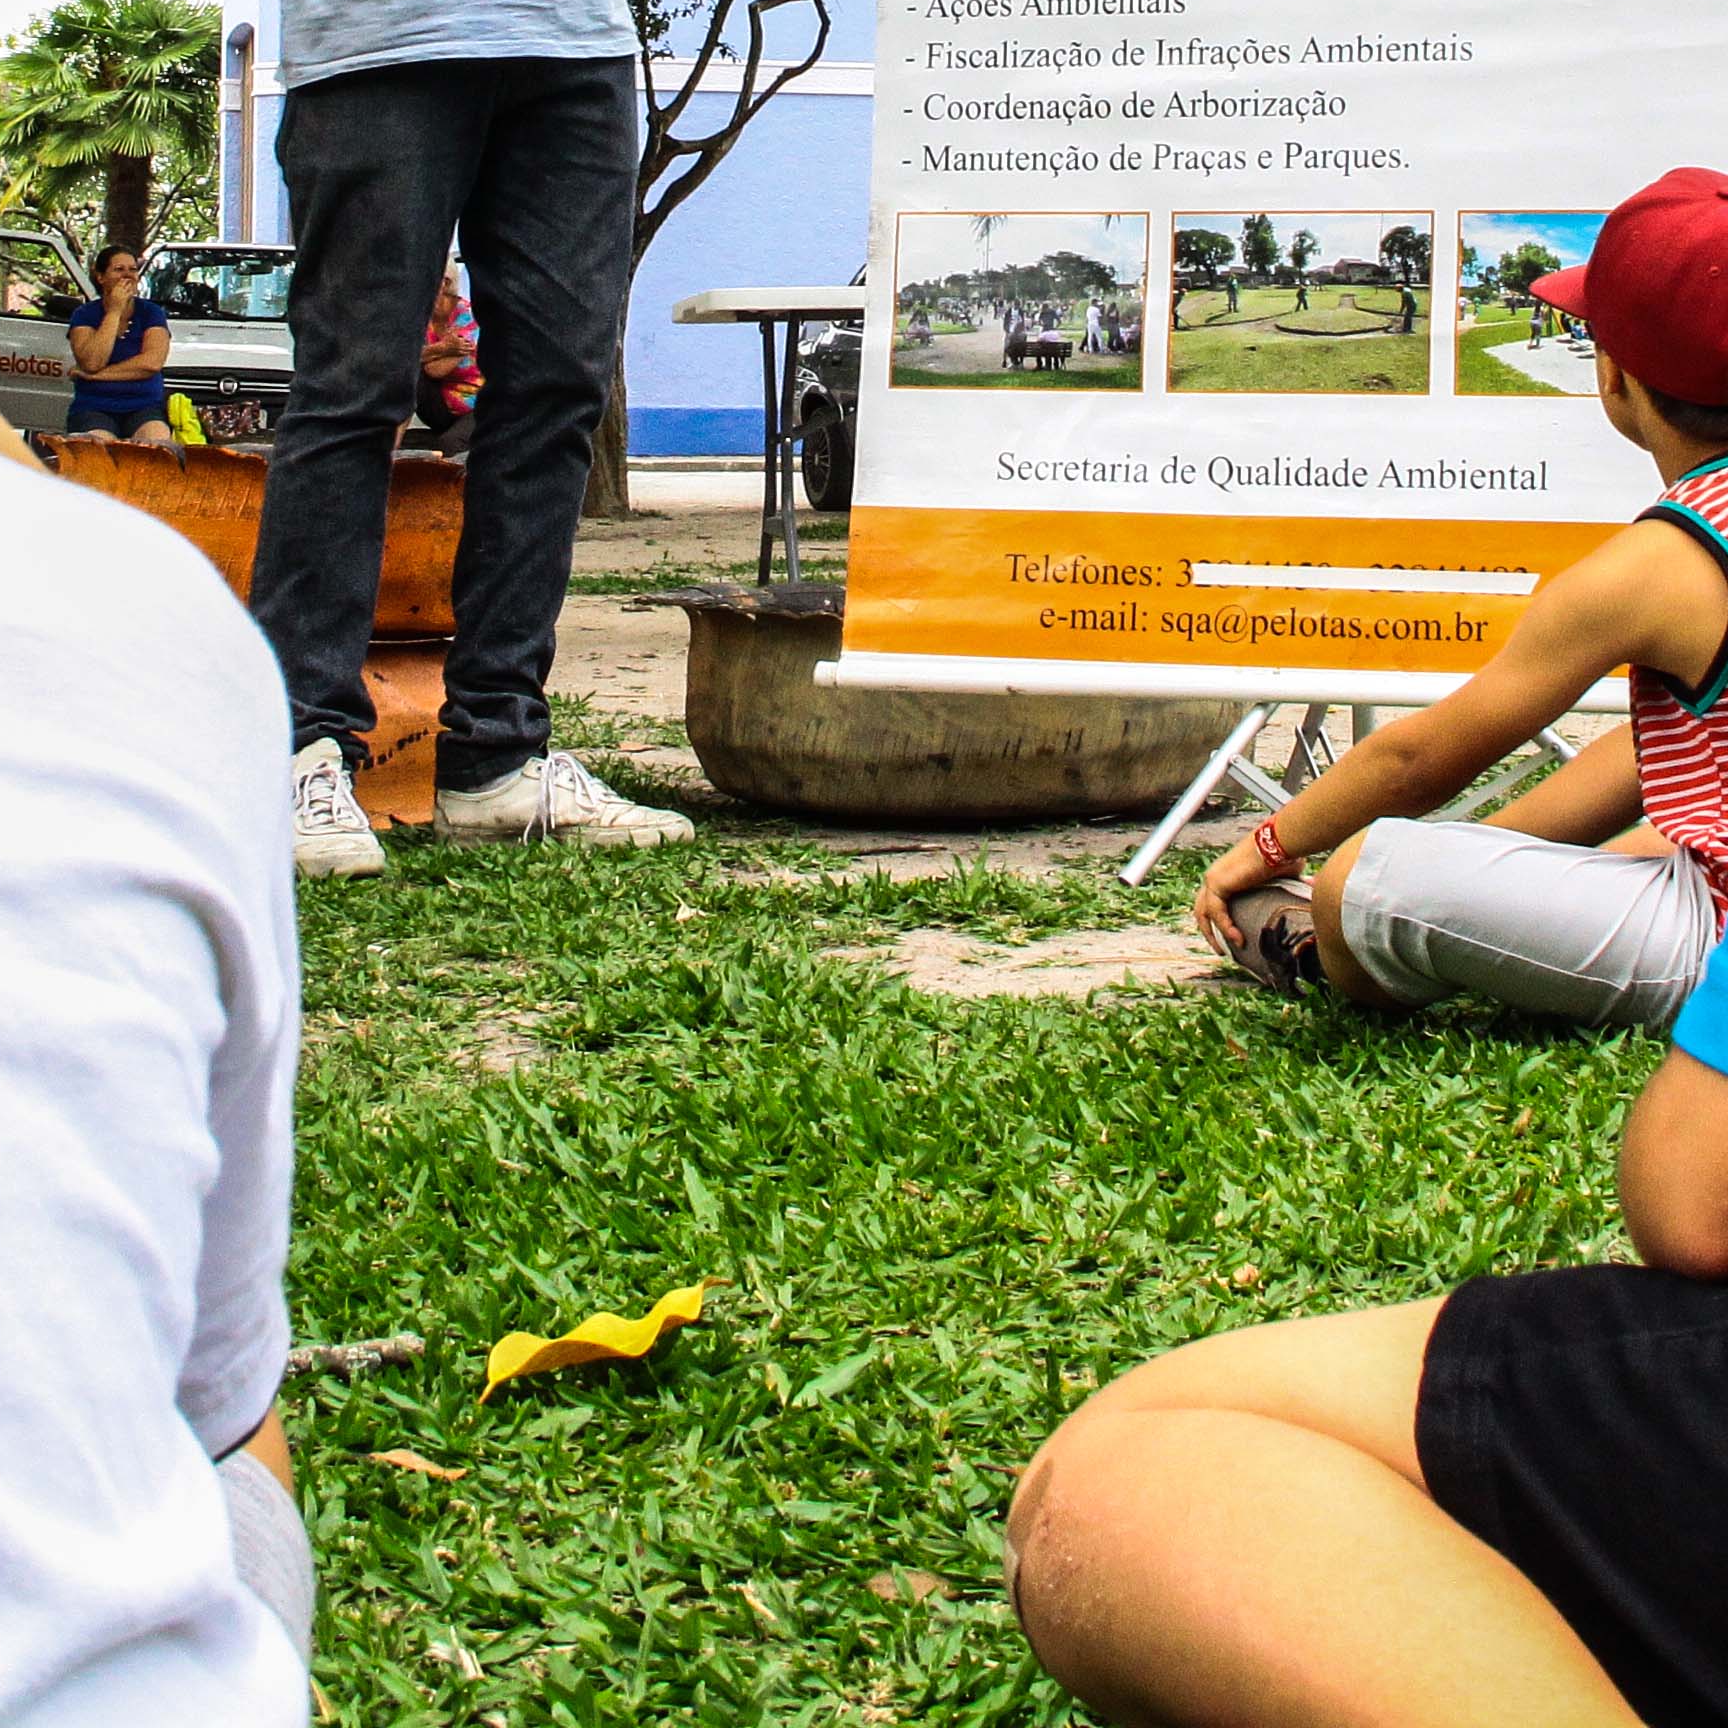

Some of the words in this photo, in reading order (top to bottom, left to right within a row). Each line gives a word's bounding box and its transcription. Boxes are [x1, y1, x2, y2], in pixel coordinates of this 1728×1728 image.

[927, 40, 1102, 74] Fiscalização
[1111, 38, 1145, 67] de
[1155, 37, 1291, 71] Infrações
[1299, 33, 1473, 64] Ambientais
[923, 92, 1112, 126] Coordenação
[1121, 90, 1155, 119] de
[1163, 88, 1346, 123] Arborização
[922, 144, 1099, 178] Manutenção
[1109, 143, 1142, 171] de
[1152, 143, 1247, 177] Praças
[1257, 150, 1273, 170] e
[1284, 142, 1410, 177] Parques.
[997, 451, 1148, 484] Secretaria
[1160, 455, 1196, 485] de
[1207, 456, 1368, 492] Qualidade
[1377, 459, 1548, 491] Ambiental
[1005, 553, 1163, 587] Telefones:
[1039, 601, 1148, 633] e-mail:
[1160, 607, 1489, 644] sqa@pelotas.com.br
